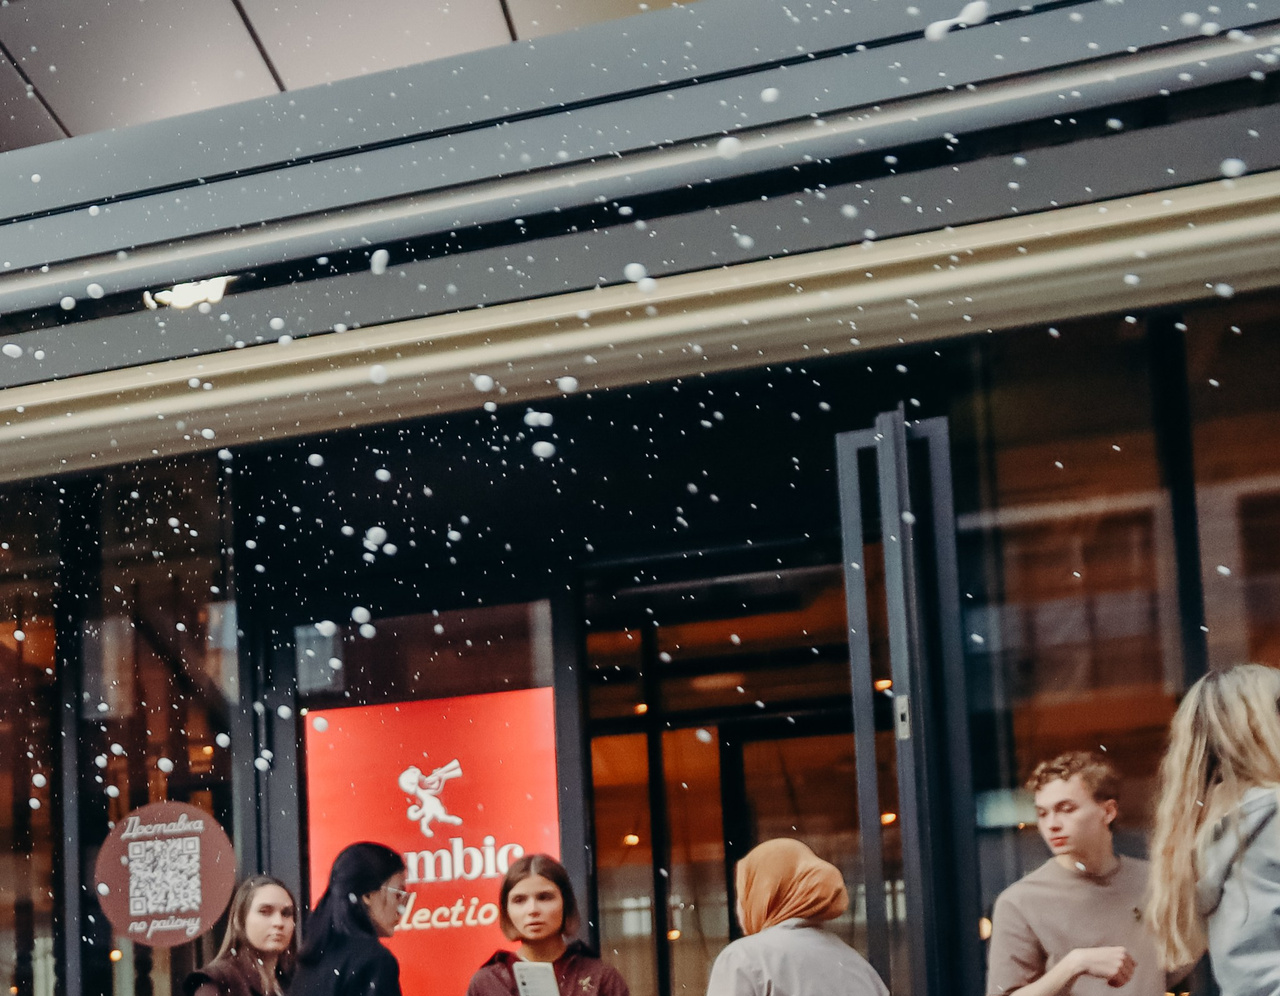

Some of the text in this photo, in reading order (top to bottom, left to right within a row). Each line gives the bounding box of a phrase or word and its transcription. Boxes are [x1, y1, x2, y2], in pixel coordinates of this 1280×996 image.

[120, 813, 204, 841] Доставка
[404, 835, 524, 884] mbic
[128, 915, 200, 939] по району
[394, 892, 499, 931] lectio
